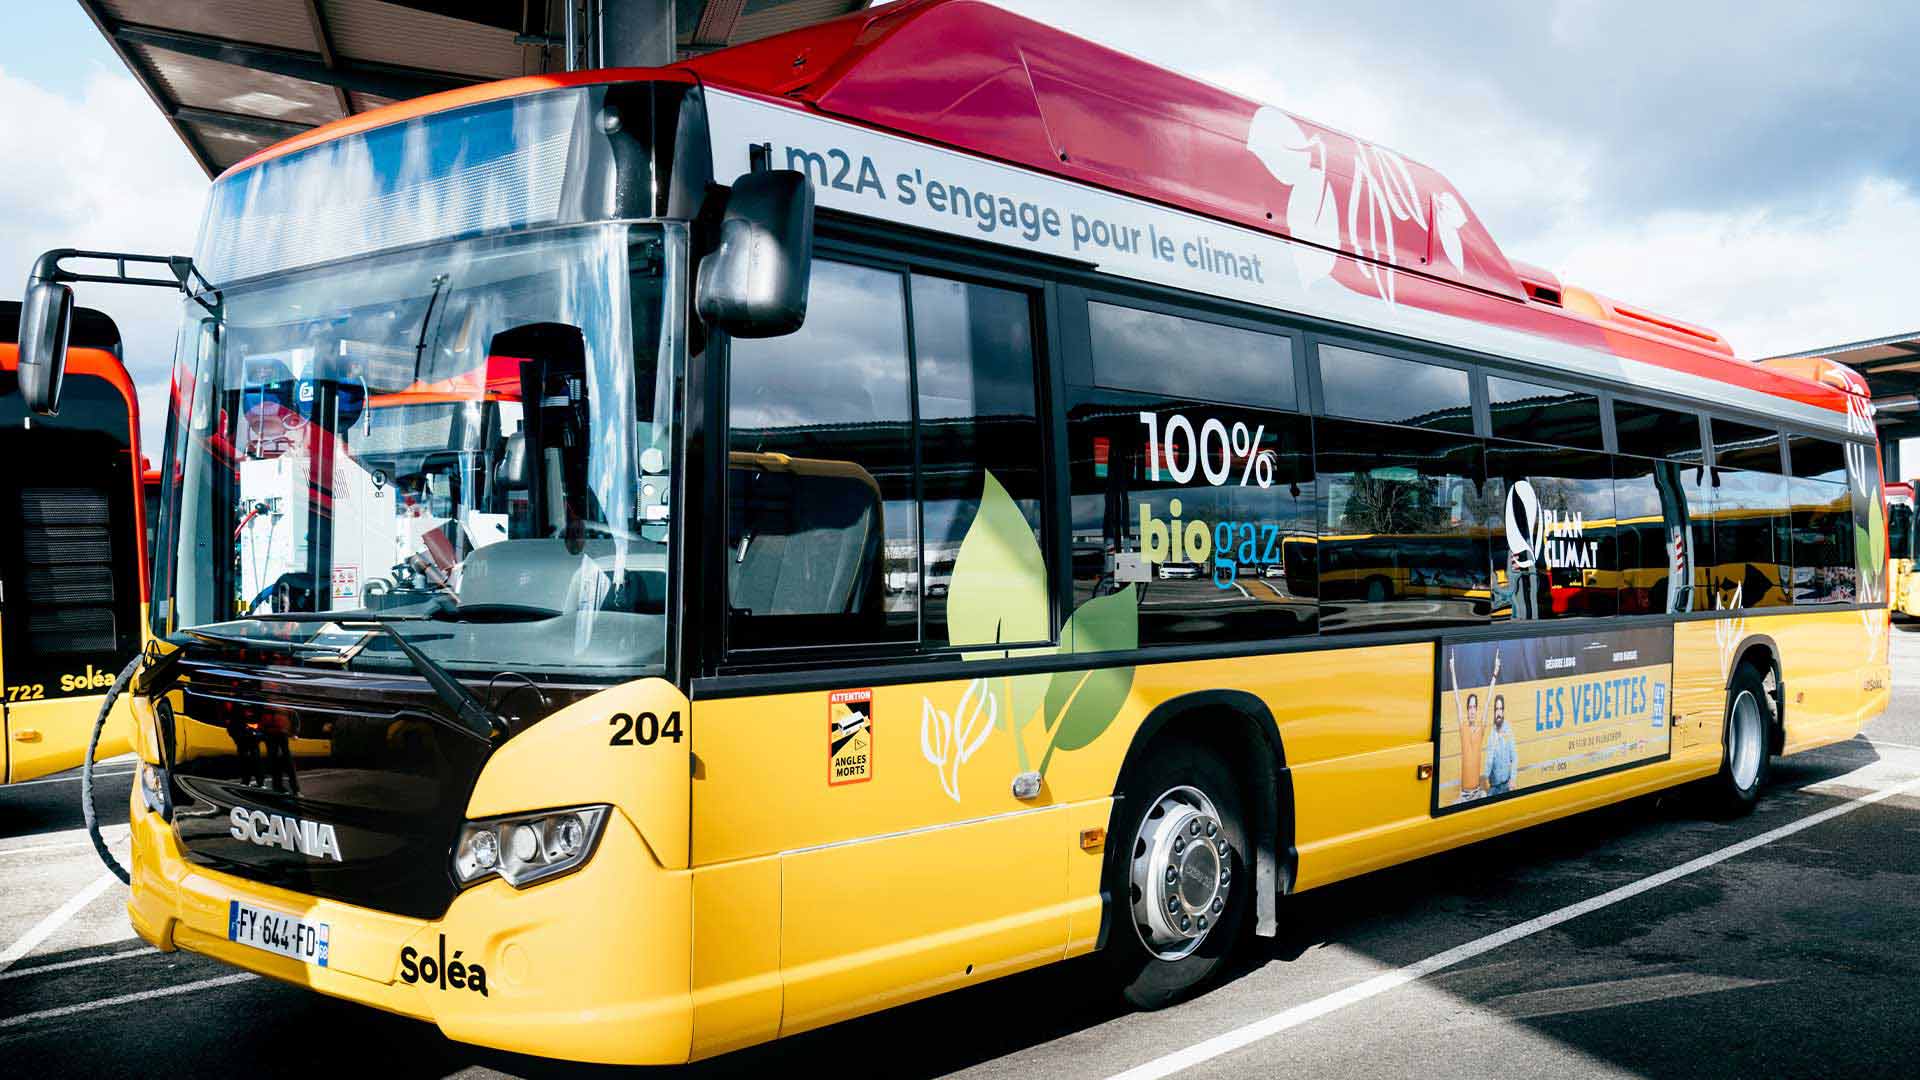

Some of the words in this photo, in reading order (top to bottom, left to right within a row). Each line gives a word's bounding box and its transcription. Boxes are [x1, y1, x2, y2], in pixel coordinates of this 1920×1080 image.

[785, 146, 886, 200] m2A
[896, 168, 1060, 242] s'engage
[1070, 213, 1141, 254] pour
[1149, 223, 1175, 262] le
[1183, 235, 1265, 284] climat
[1140, 411, 1273, 489] 100%
[1139, 498, 1281, 590] biogaz
[1544, 509, 1583, 538] PLAN
[1544, 540, 1598, 570] CLIMAT
[7, 684, 45, 702] 722
[1536, 686, 1565, 733] LES
[1571, 675, 1647, 727] VEDETTES
[609, 711, 684, 746] 204
[835, 754, 867, 767] ANGLES
[836, 765, 865, 777] MORTS
[229, 806, 343, 863] SCANIA
[400, 933, 489, 998] Soléa
